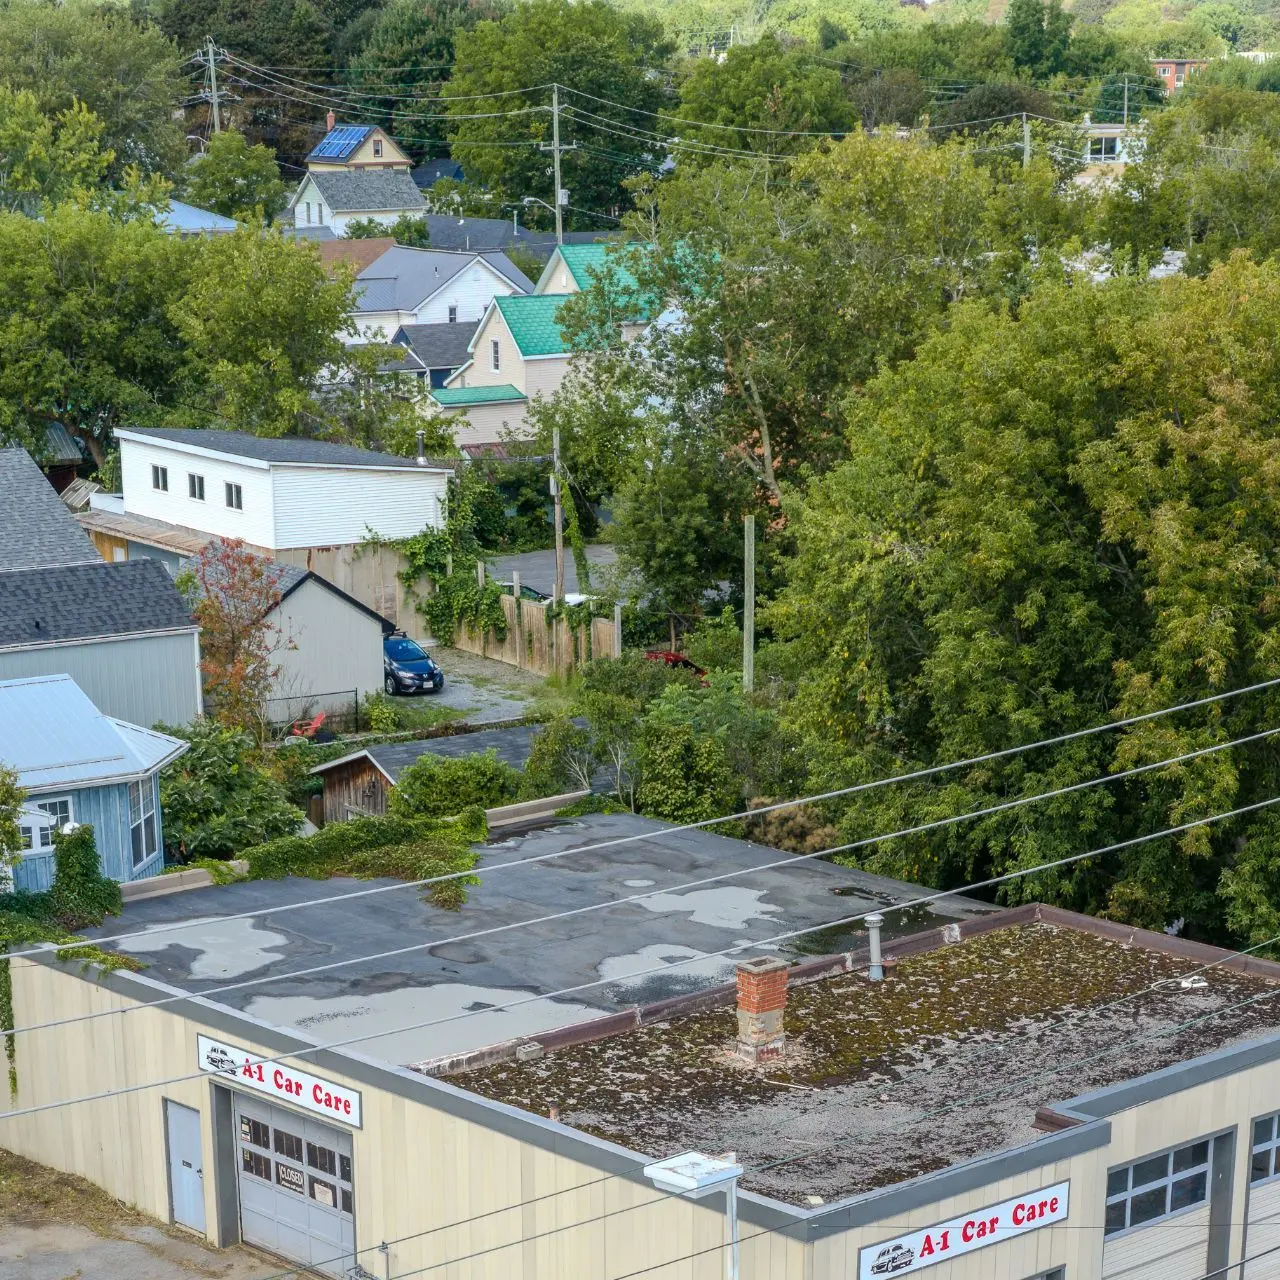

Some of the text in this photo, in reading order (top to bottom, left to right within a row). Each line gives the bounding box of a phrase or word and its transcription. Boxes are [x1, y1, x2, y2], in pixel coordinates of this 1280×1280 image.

[242, 1058, 352, 1115] A-1 Car Care
[280, 1165, 304, 1185] CLOSED
[919, 1196, 1060, 1258] A-1 Car Care
